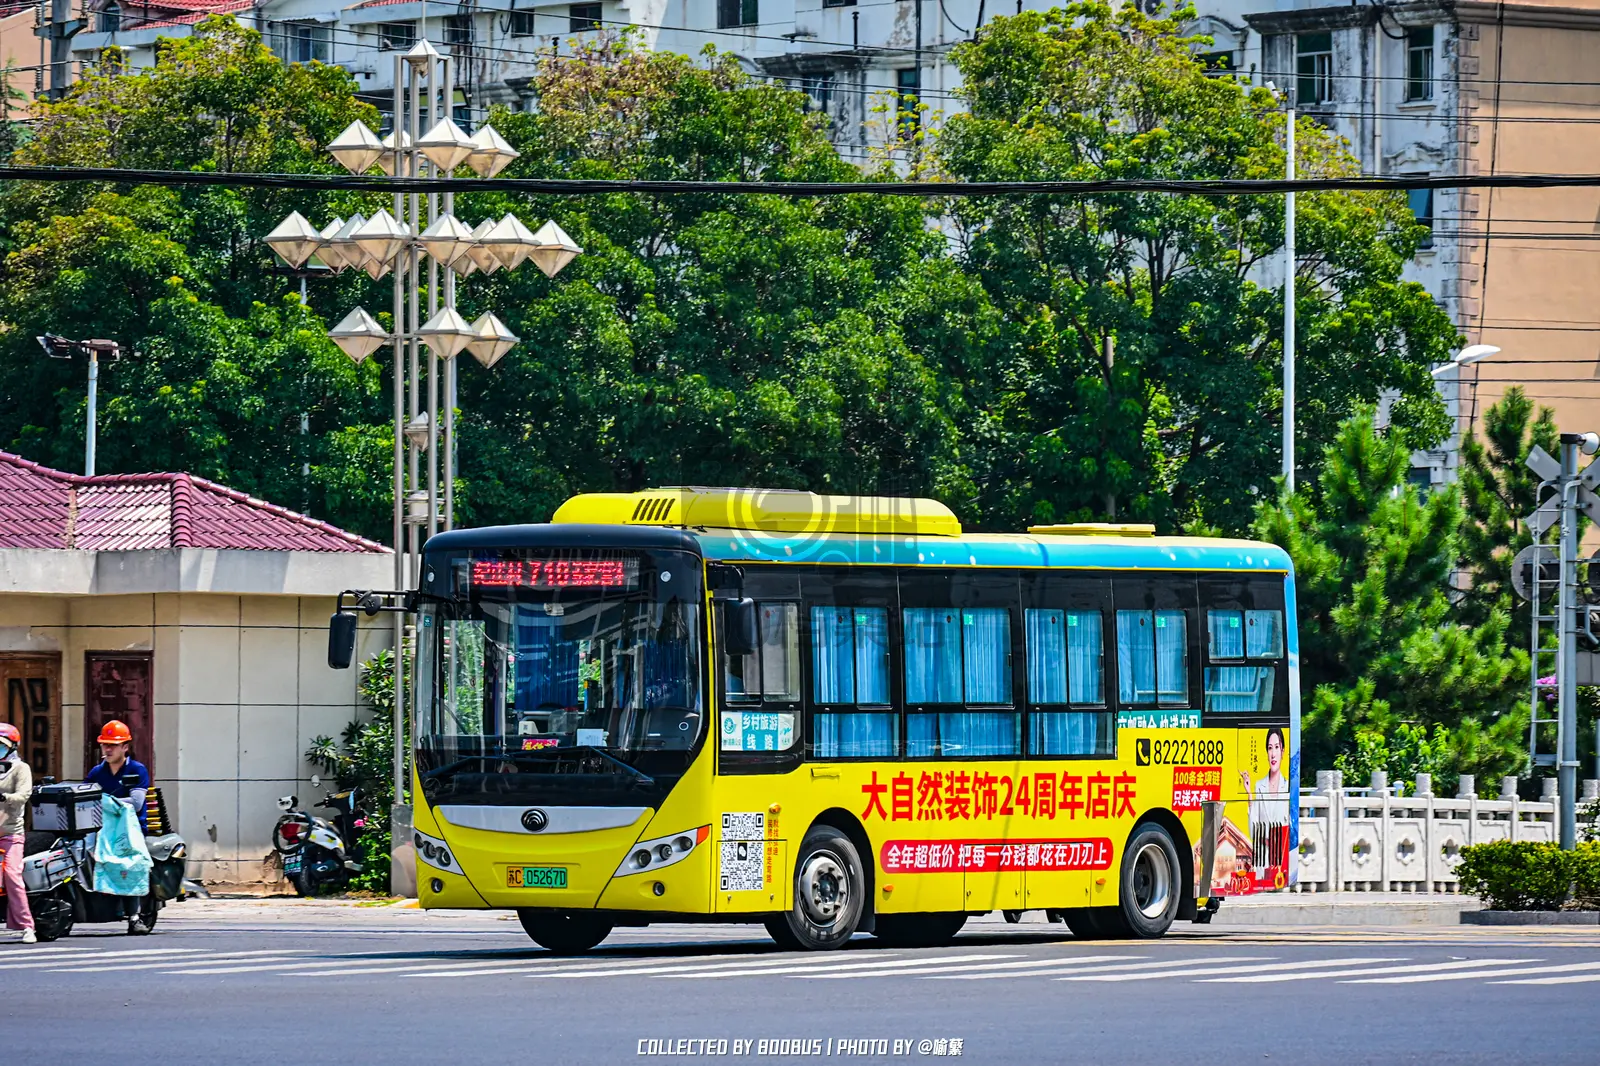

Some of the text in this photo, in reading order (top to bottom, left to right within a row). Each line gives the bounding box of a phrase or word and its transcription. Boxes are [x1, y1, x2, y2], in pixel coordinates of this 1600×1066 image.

[742, 713, 778, 731] 乡村旅游
[746, 733, 774, 751] 线路
[1153, 740, 1224, 765] 82221888
[1174, 770, 1221, 786] 100条金项链
[861, 769, 1137, 822] 大自然装饰24周年店庆
[887, 842, 1108, 869] 全年超低价 把每一分钱都花在刀刃上
